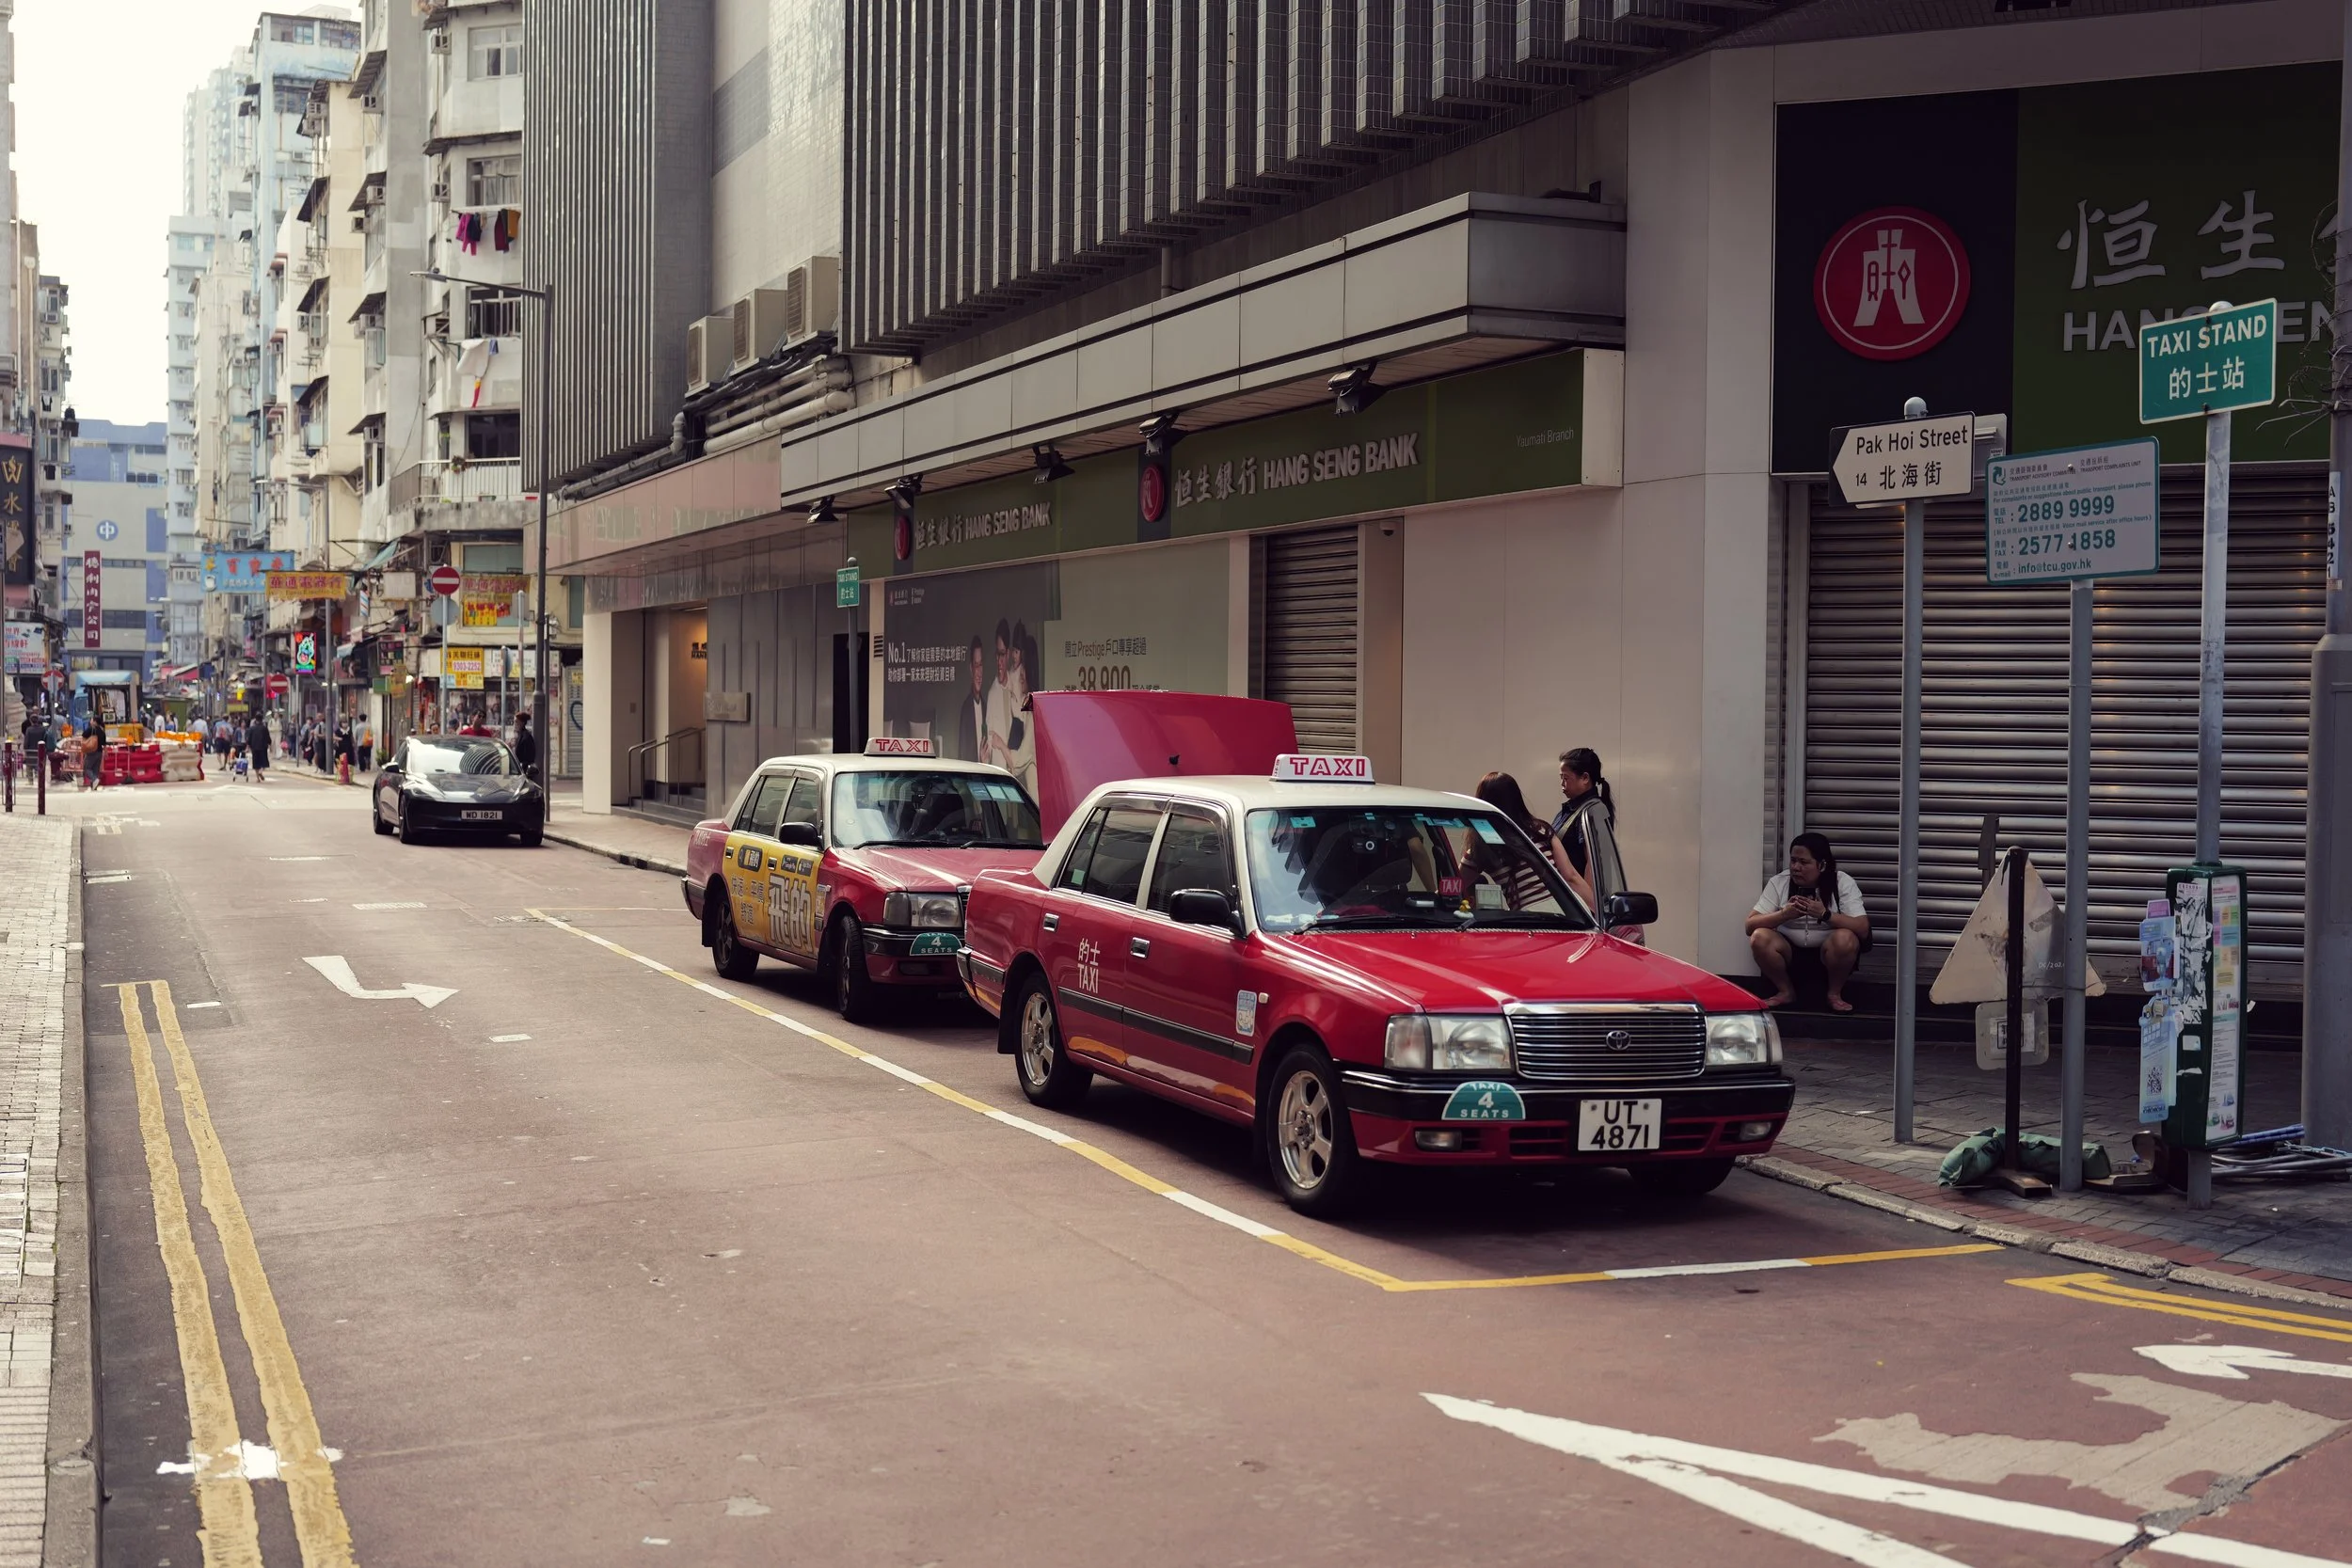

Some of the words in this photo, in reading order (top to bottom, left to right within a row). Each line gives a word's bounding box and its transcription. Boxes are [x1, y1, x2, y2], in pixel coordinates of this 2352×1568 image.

[2056, 190, 2338, 290] 恒生
[2147, 330, 2191, 358] TAXI
[2198, 314, 2267, 349] STAND
[2169, 356, 2245, 400] 的士站
[1517, 430, 1546, 448] Yaumati
[1548, 426, 1574, 443] Branch
[1856, 435, 1883, 454] Pak
[1889, 431, 1915, 451] Hoi
[1919, 424, 1968, 449] Street
[1175, 456, 1258, 507] 恒生銀行
[1263, 453, 1310, 490] HANG
[1312, 444, 1361, 483] SENG
[1365, 433, 1419, 473] BANK
[1855, 472, 1867, 487] 14
[1880, 461, 1942, 490] 北海街
[2104, 462, 2130, 470] COMPLAINTS
[2001, 494, 2026, 502] complaints
[2033, 491, 2061, 499] suggestions
[2017, 500, 2064, 523] 2889
[2069, 495, 2115, 517] 9999
[915, 515, 963, 550] 恒生銀行
[965, 514, 991, 540] HANG
[993, 508, 1020, 535] SENG
[1022, 501, 1051, 529] BANK
[2018, 533, 2064, 556] 2577
[2071, 529, 2116, 551] 1858
[2018, 558, 2092, 574] info@tcu.gov.hk
[888, 641, 906, 663] No.1
[876, 738, 930, 753] TAXI
[1289, 757, 1366, 777] TAXI
[1441, 879, 1462, 893] TAXI
[931, 936, 942, 946] 4
[1078, 938, 1100, 966] 的士
[1077, 963, 1099, 994] TAXI
[1478, 1091, 1494, 1109] 4
[1603, 1100, 1638, 1125] UT
[1460, 1108, 1509, 1118] SEATS
[1590, 1124, 1649, 1149] 4871
